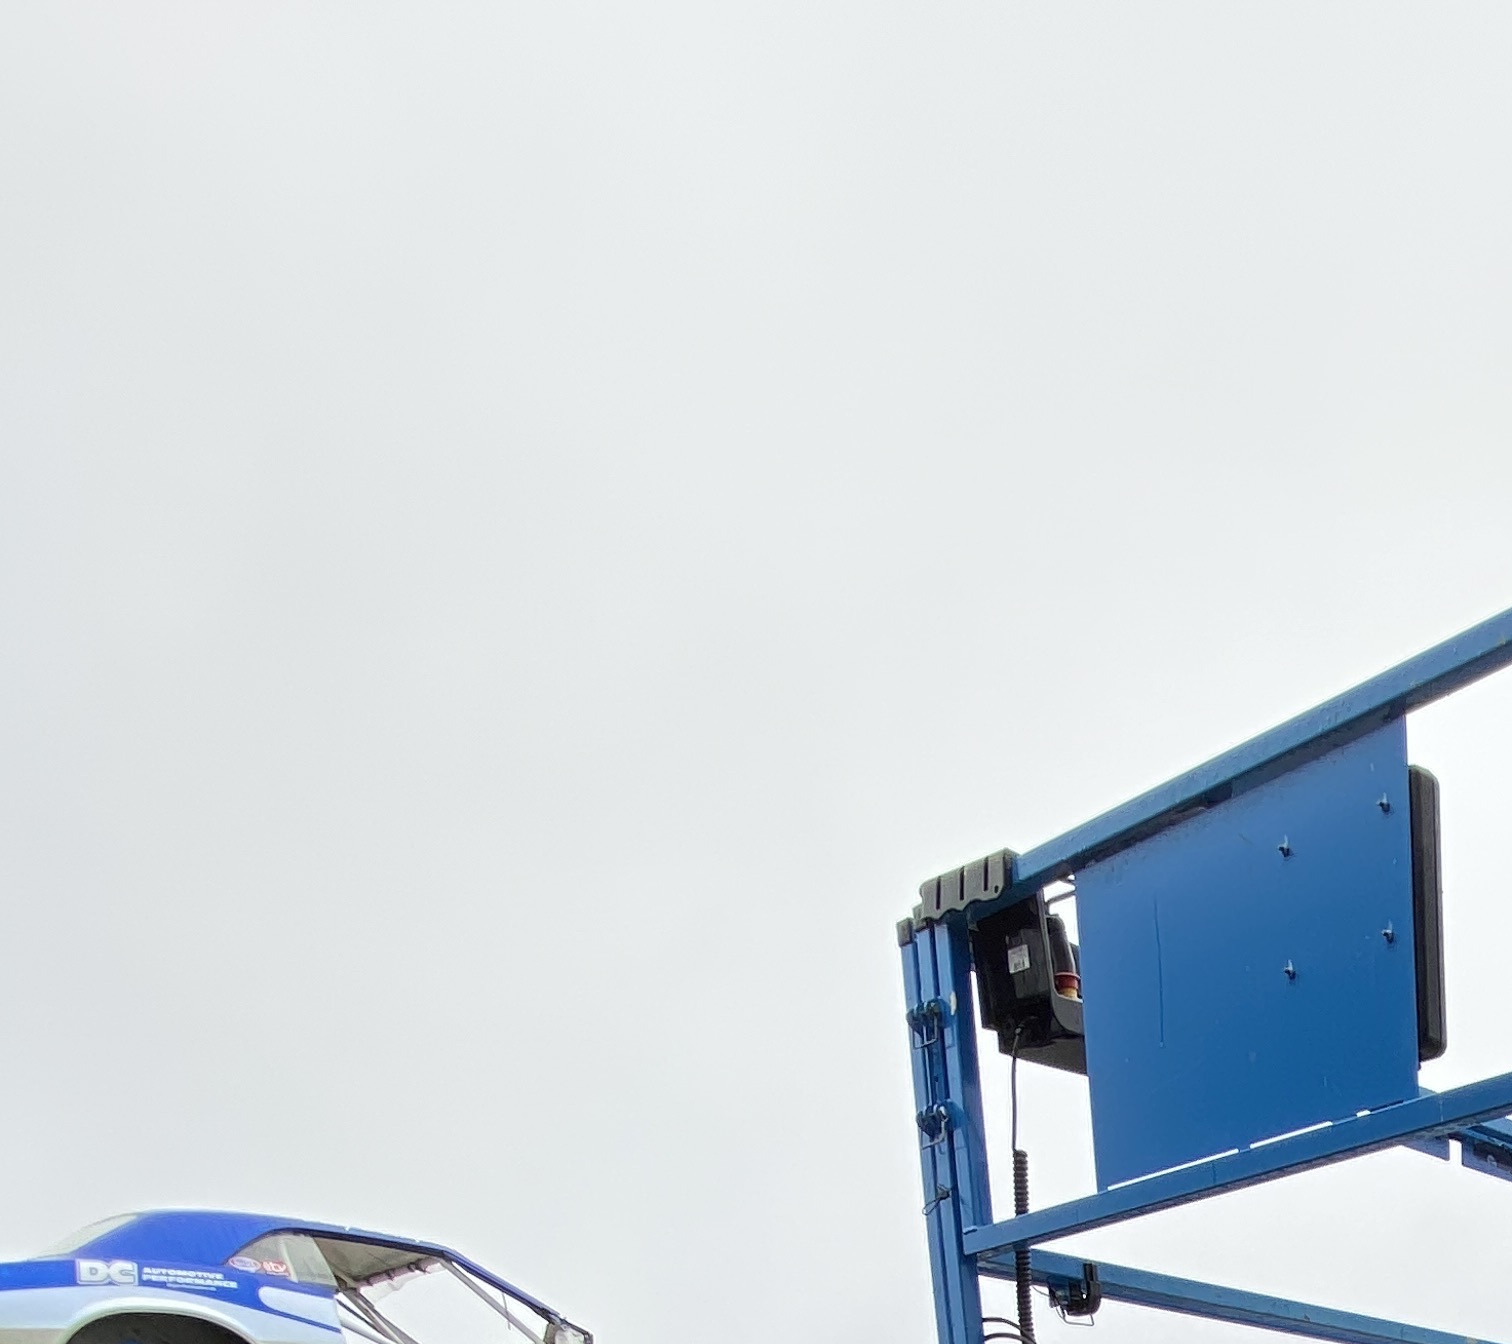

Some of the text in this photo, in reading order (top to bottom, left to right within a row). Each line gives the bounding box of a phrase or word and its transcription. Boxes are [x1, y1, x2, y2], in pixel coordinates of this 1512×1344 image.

[77, 1259, 137, 1285] DC
[143, 1267, 224, 1280] AUTOMOTIVE
[142, 1274, 238, 1289] PERFORMANCE
